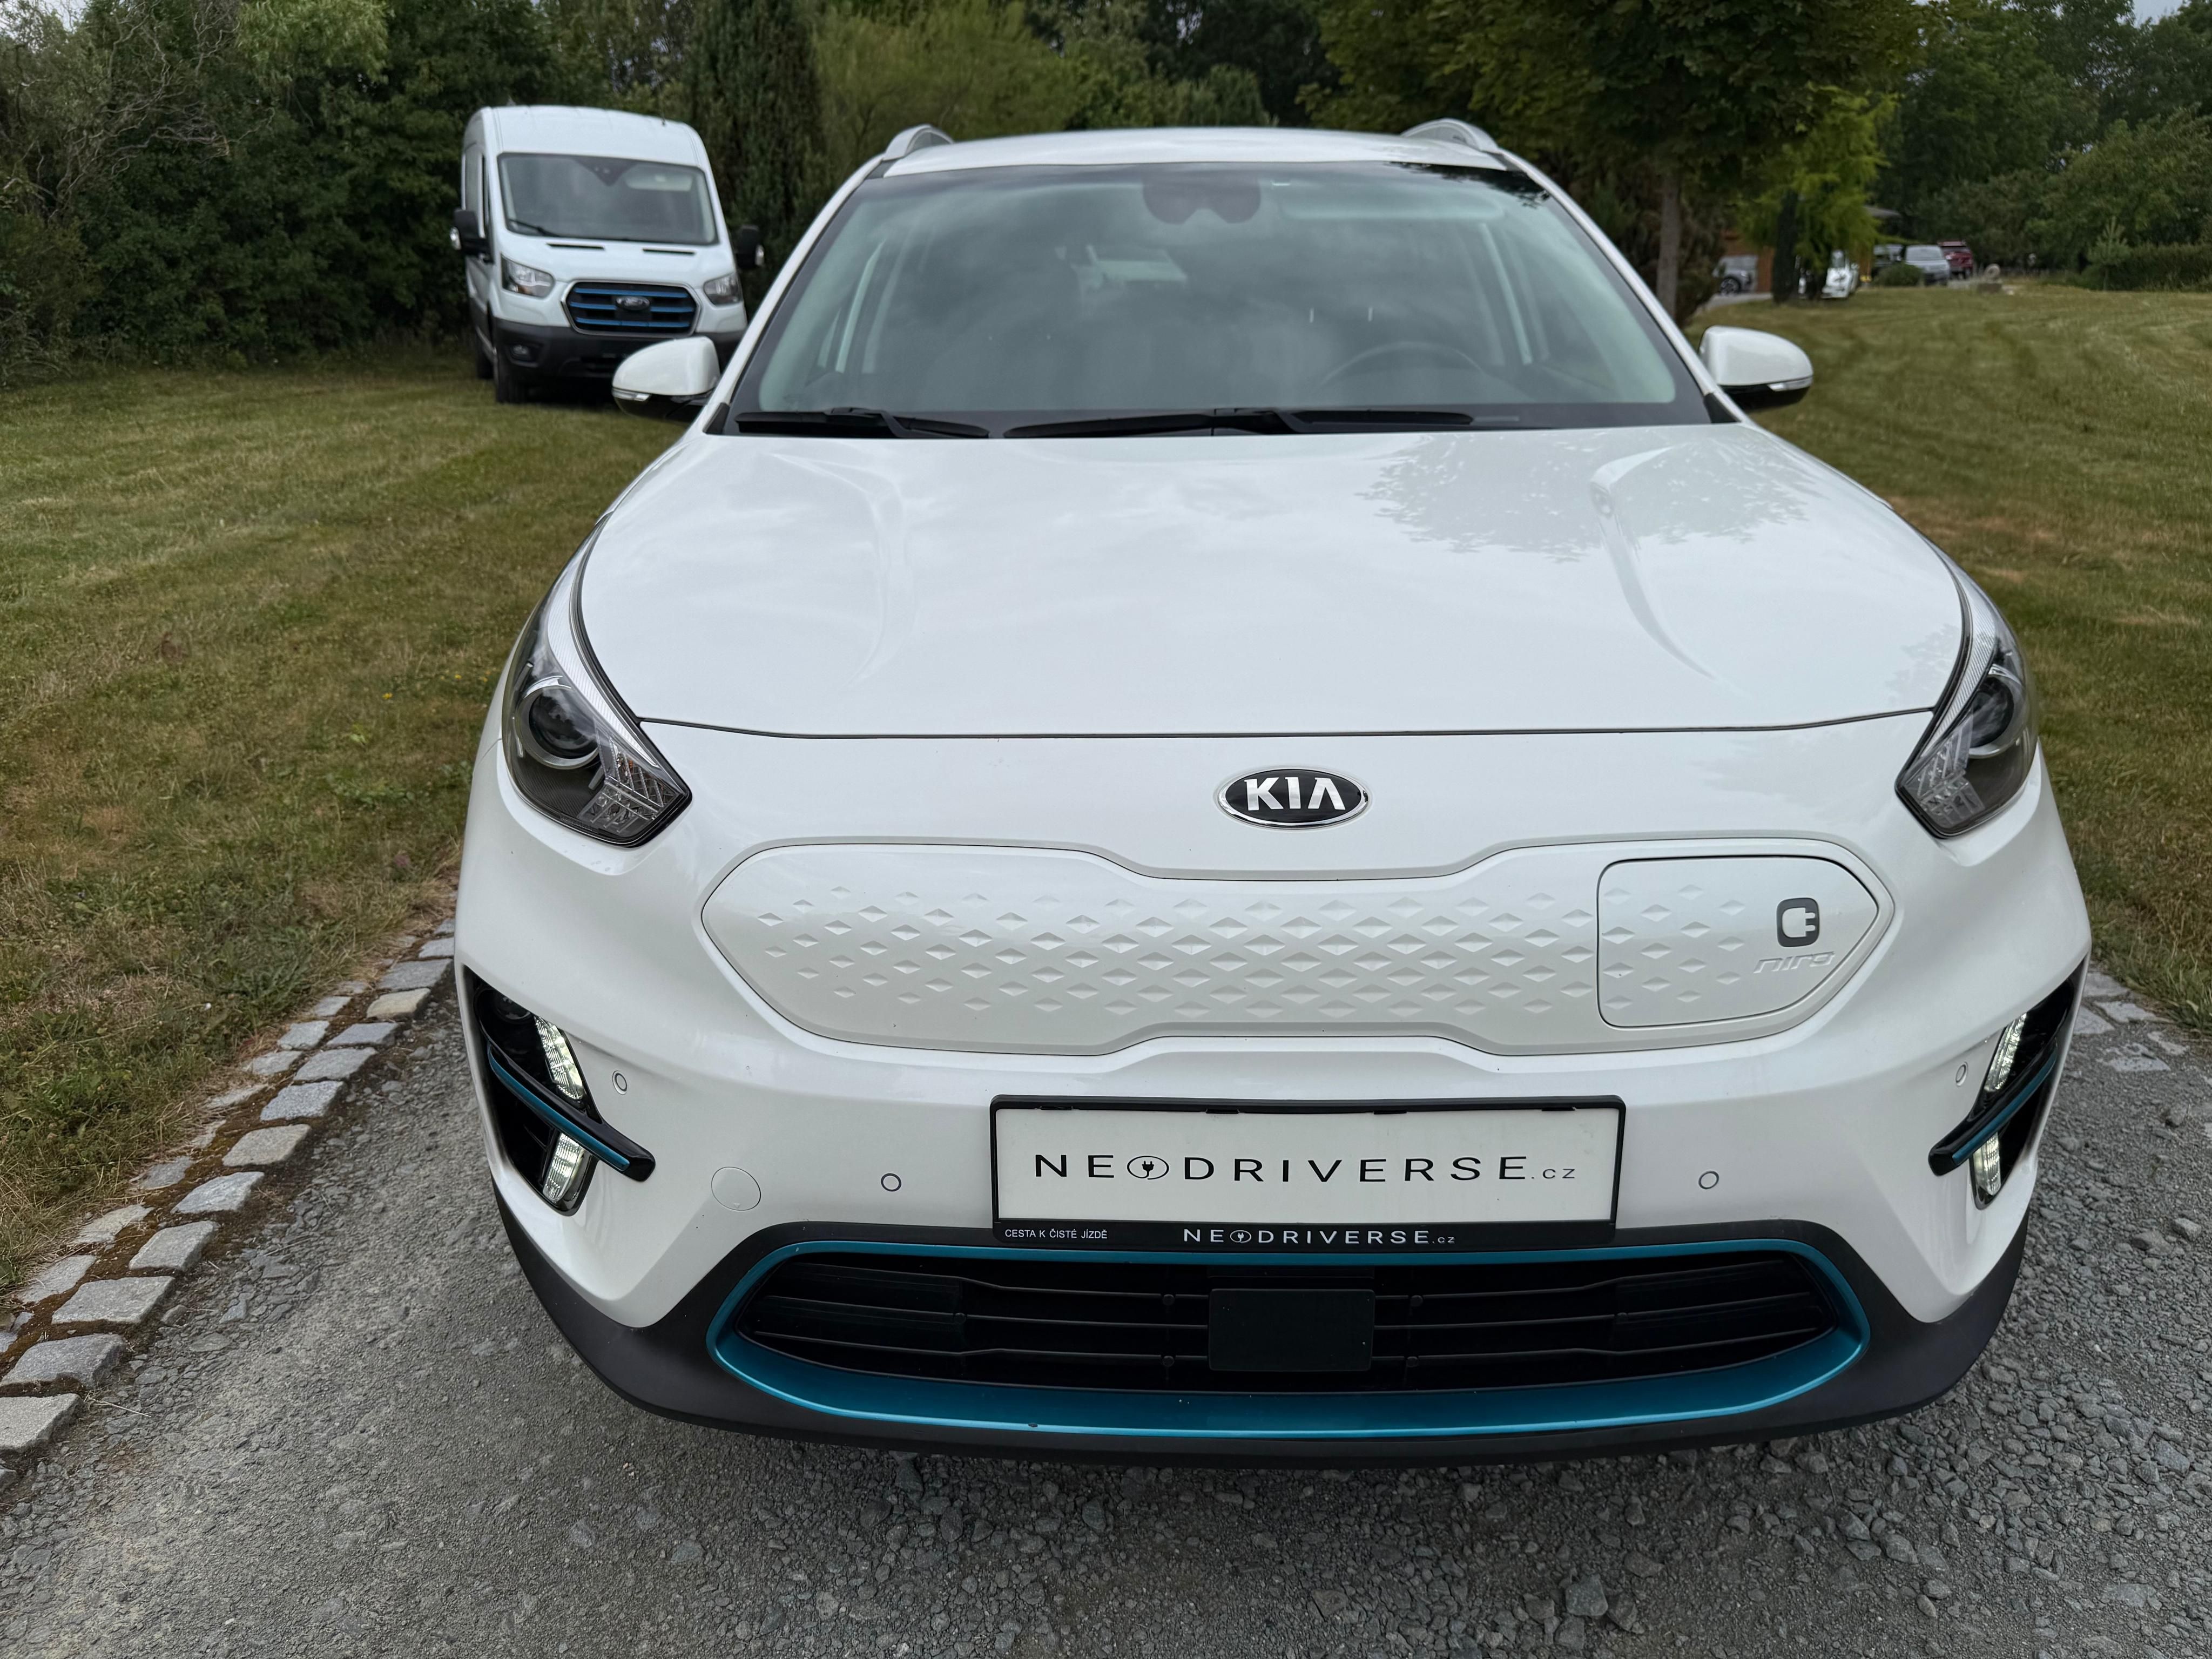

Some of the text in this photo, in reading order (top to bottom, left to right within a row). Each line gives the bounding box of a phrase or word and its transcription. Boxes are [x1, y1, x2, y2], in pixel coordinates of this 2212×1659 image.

[1244, 777, 1346, 811] KIA
[1004, 1228, 1108, 1239] CESTA K ČISTÉ JÍZDĚ
